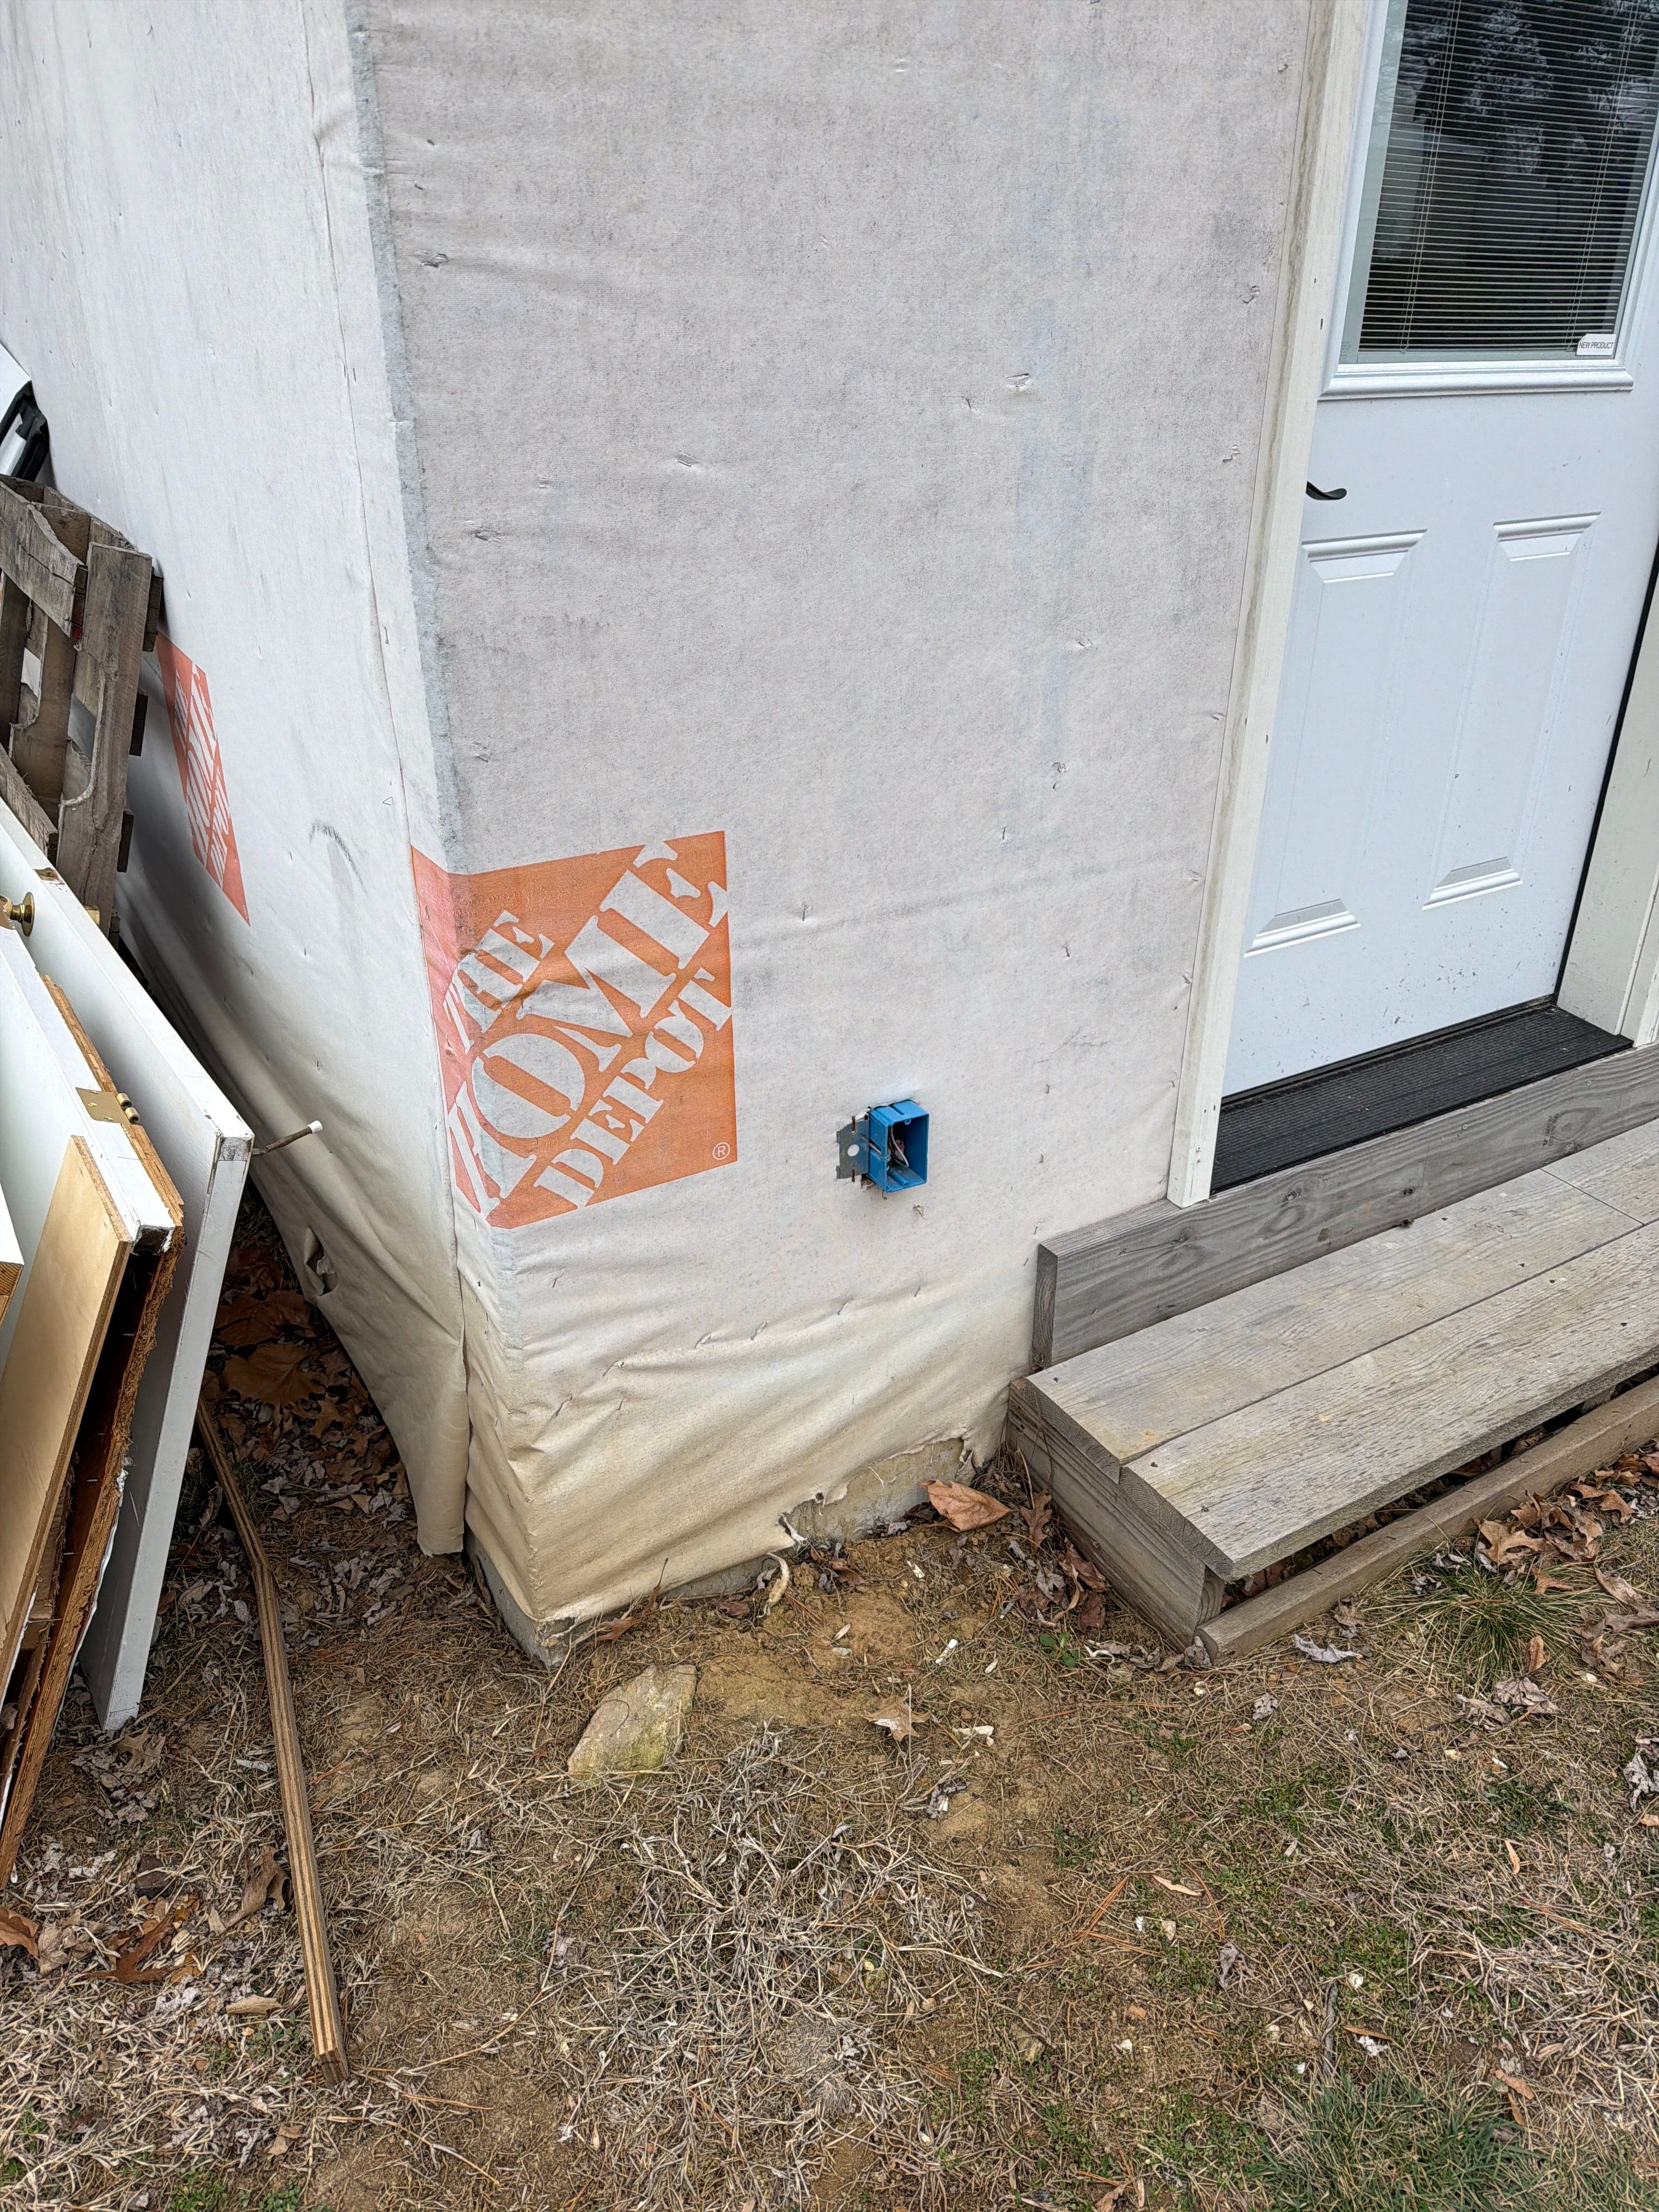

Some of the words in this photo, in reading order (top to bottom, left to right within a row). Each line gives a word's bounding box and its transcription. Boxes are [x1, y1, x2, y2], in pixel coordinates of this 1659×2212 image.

[443, 910, 555, 1054] THE
[448, 841, 726, 1218] HOME
[533, 968, 731, 1207] DEPOT
